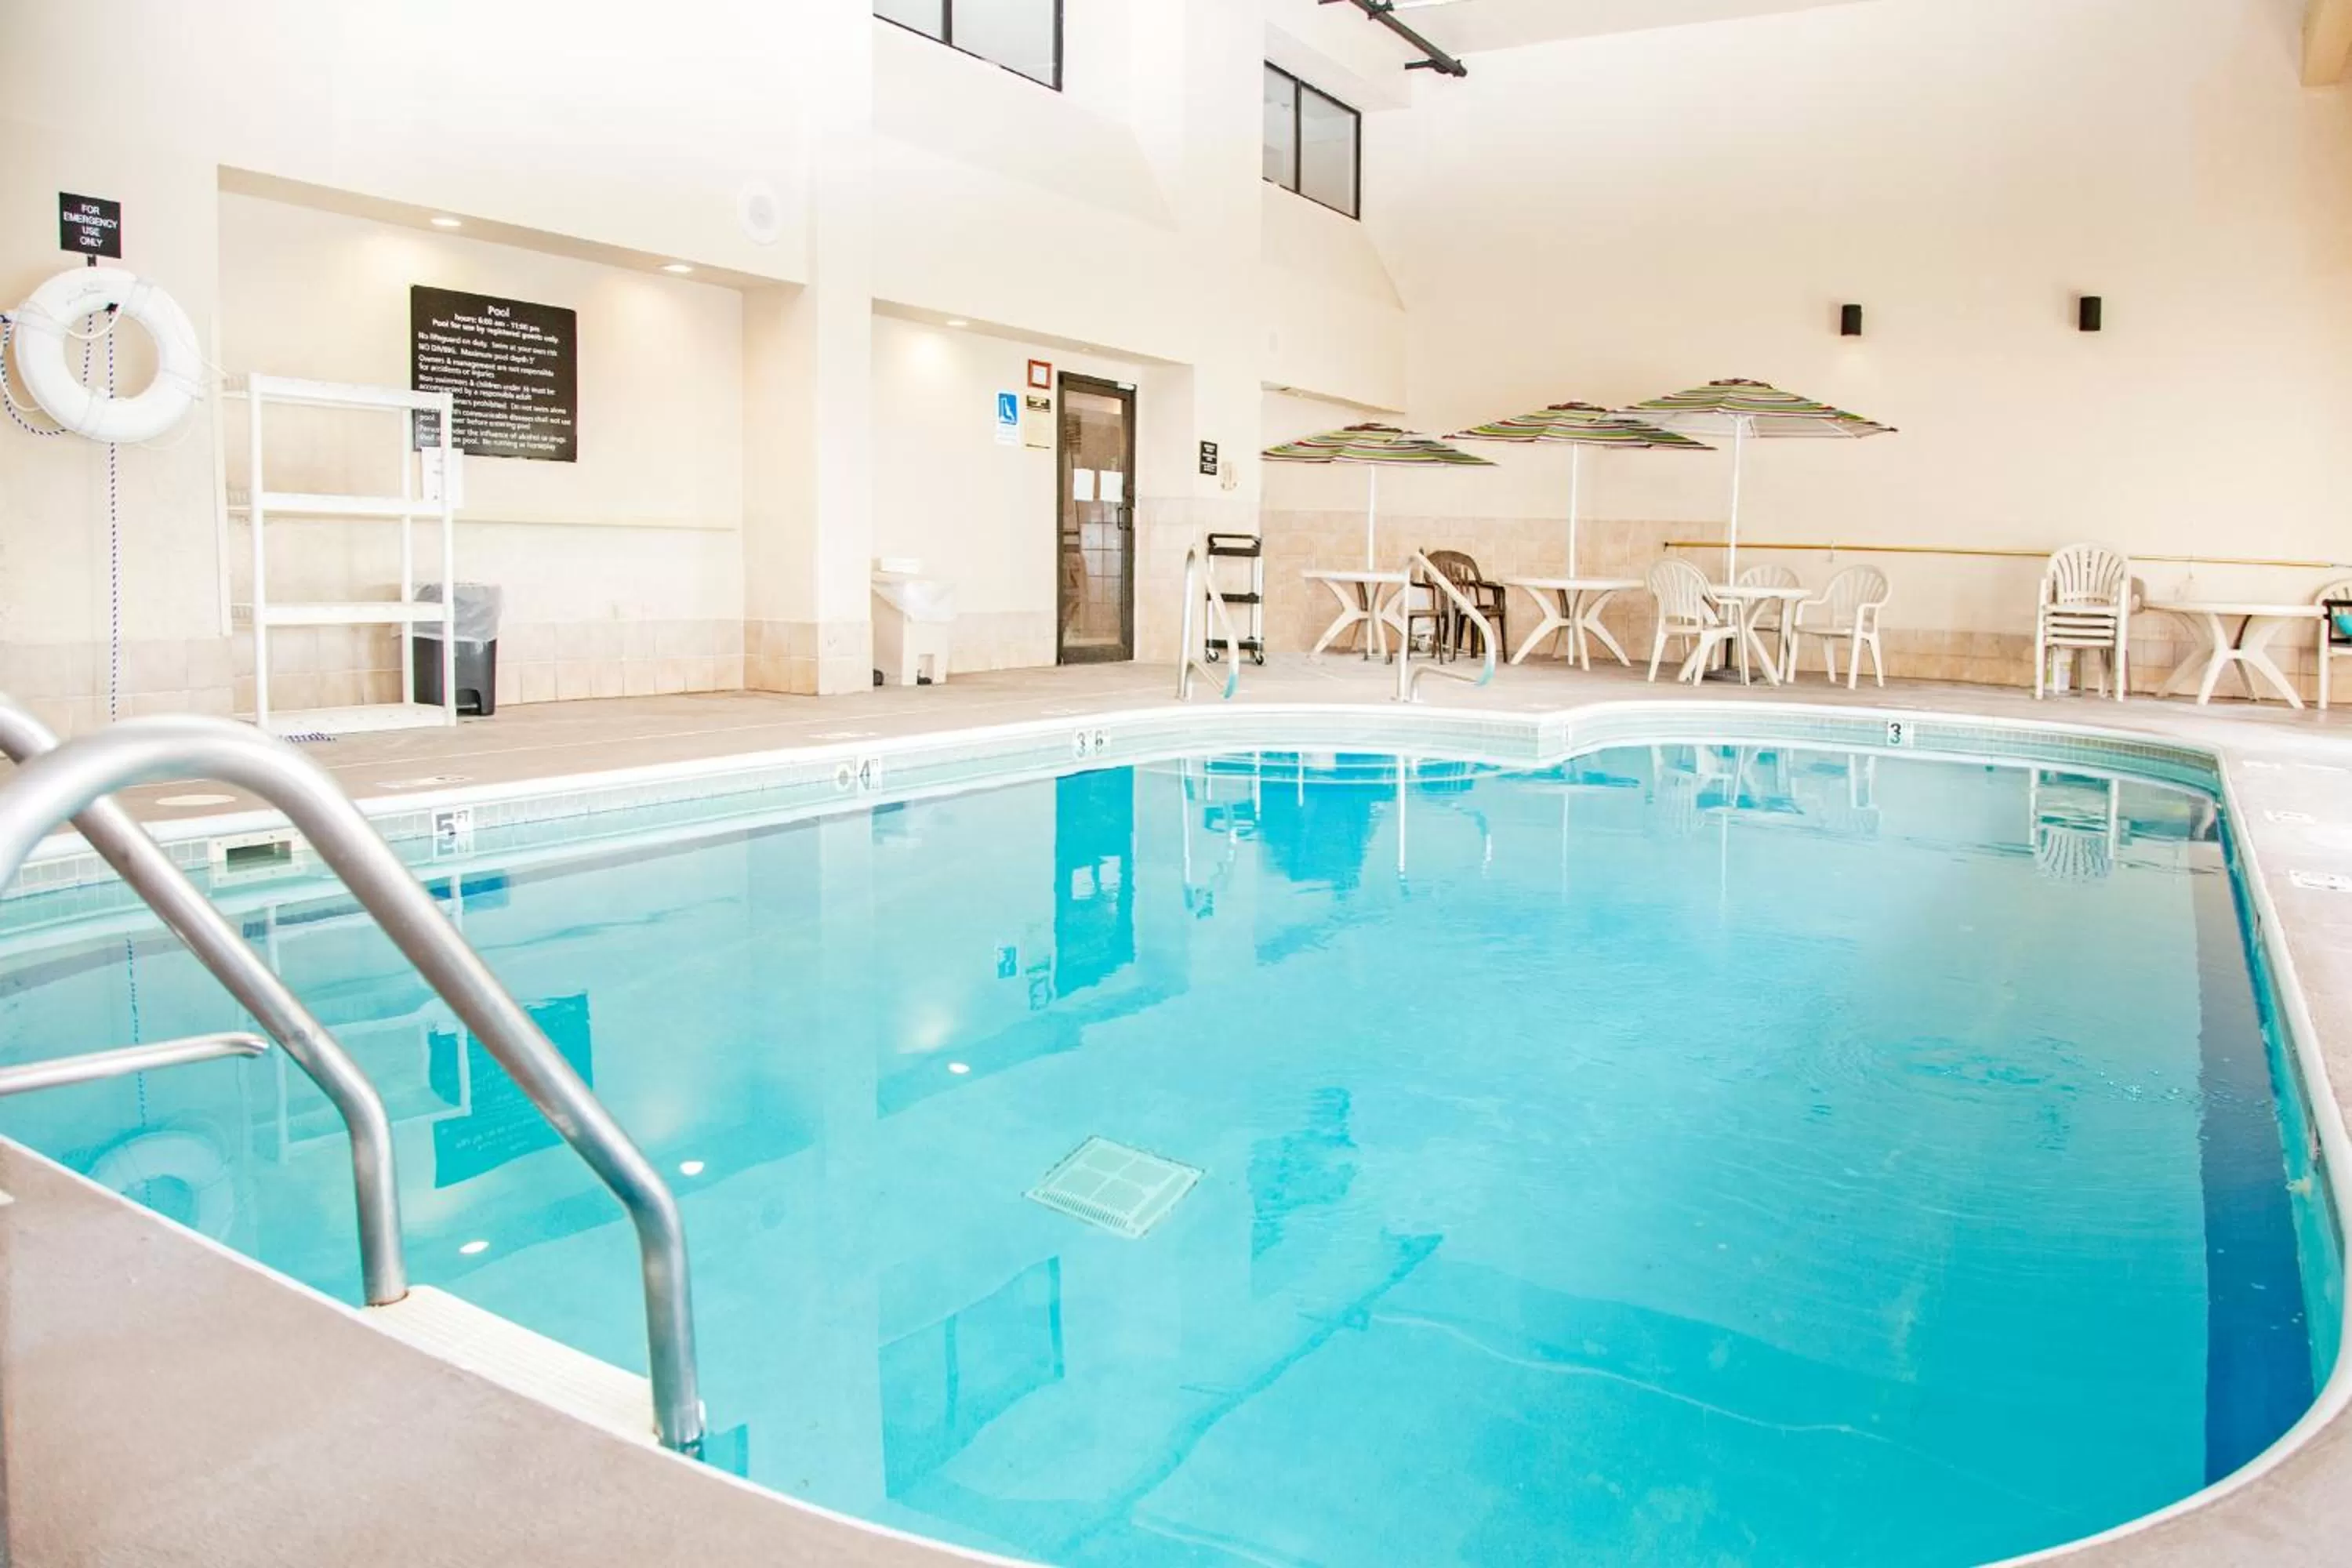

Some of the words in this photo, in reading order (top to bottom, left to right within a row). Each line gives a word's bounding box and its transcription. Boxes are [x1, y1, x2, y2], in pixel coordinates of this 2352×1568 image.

[81, 204, 100, 215] FOR
[64, 211, 118, 228] EMERGENCY
[82, 225, 100, 237] USE
[79, 236, 103, 248] ONLY
[487, 305, 510, 318] Pool
[454, 314, 477, 323] hours:
[529, 325, 540, 333] pm
[432, 318, 449, 328] Pool
[476, 324, 485, 335] by
[486, 326, 521, 337] registered
[521, 332, 543, 341] guests
[543, 335, 559, 345] only
[418, 331, 429, 339] No
[429, 332, 462, 345] lifeguard
[517, 346, 532, 354] your
[418, 343, 430, 351] NO
[459, 347, 493, 358] Maximum
[493, 353, 509, 361] pool
[509, 354, 528, 364] depth
[418, 354, 445, 365] Owners
[446, 357, 452, 365] &
[452, 360, 496, 370] management
[520, 367, 554, 377] responsible
[418, 361, 429, 371] for
[430, 365, 462, 375] accidents
[469, 379, 474, 387] &
[476, 380, 502, 390] children
[503, 383, 521, 391] under
[531, 386, 546, 394] must
[463, 387, 473, 397] by
[479, 390, 515, 401] responsible
[466, 417, 488, 426] before
[509, 413, 534, 423] diseases
[466, 428, 479, 437] the
[480, 429, 509, 439] influence
[518, 432, 540, 441] alcohol
[436, 812, 456, 836] 5
